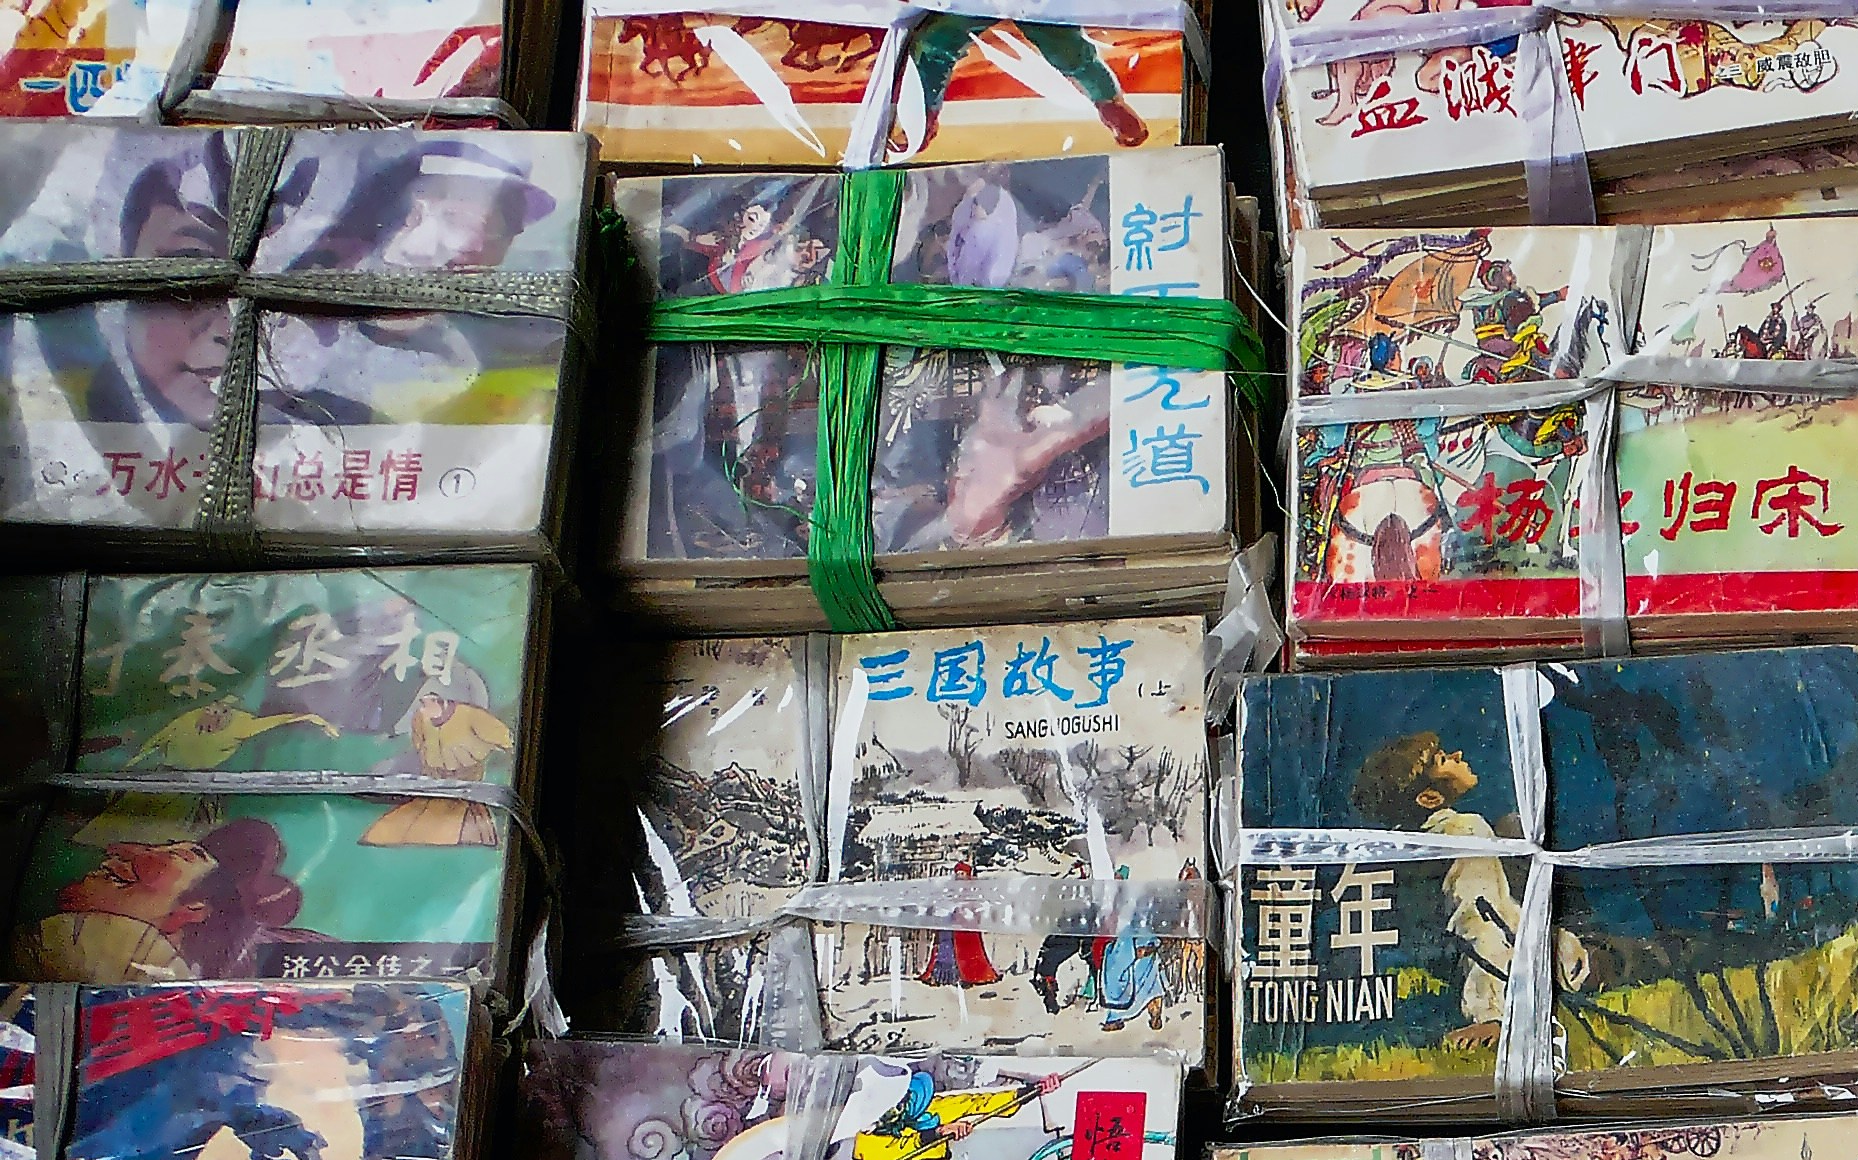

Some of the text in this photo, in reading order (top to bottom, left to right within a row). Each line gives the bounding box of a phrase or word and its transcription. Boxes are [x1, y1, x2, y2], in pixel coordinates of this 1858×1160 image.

[1756, 49, 1832, 73] 威震敌胆
[1122, 194, 1210, 494] 紂无道
[96, 446, 422, 501] 万水山总是情
[860, 636, 1134, 709] 三国故事
[1250, 862, 1400, 979] 童年
[282, 954, 464, 978] 济公全传之一
[1249, 974, 1395, 1024] TONG NIAN
